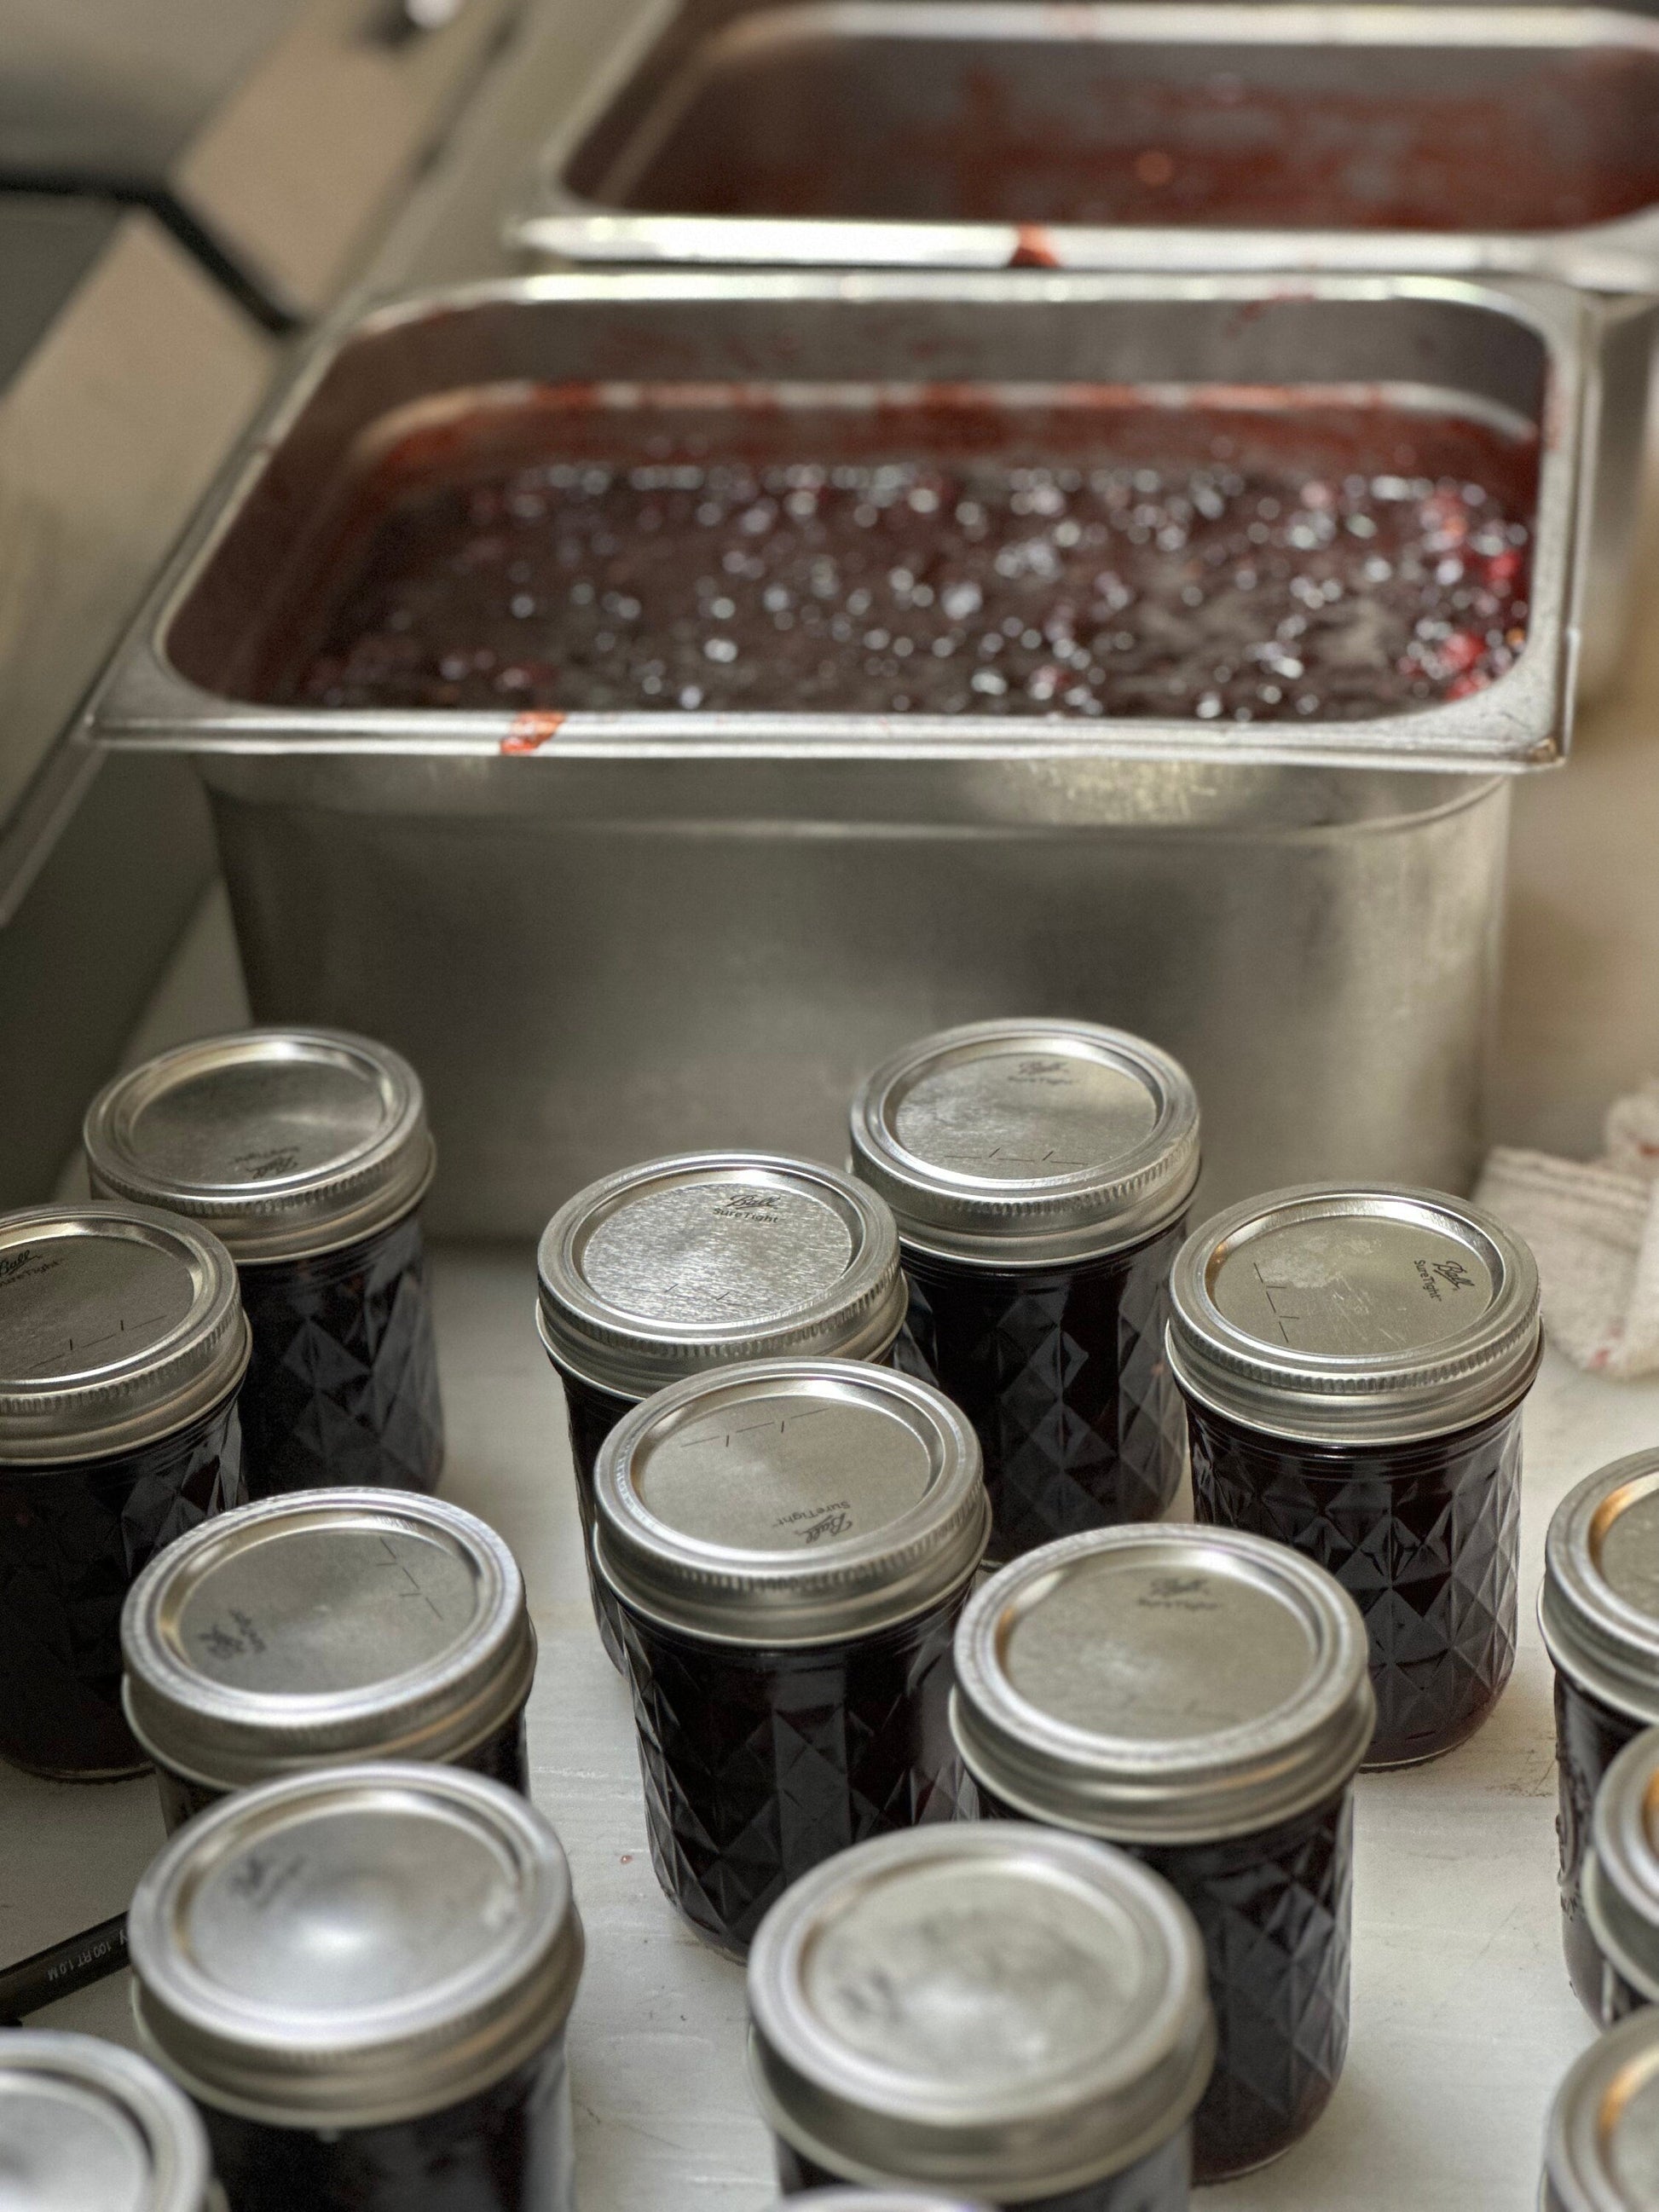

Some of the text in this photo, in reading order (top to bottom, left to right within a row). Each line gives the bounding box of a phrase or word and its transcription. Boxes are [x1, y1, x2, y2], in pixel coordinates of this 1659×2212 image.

[724, 1194, 781, 1210] Ball
[713, 1208, 779, 1223] SureTight
[1413, 1260, 1441, 1299] SureTight
[1432, 1261, 1476, 1290] Ball
[777, 1501, 851, 1525] SureTight
[796, 1512, 853, 1545] Ball
